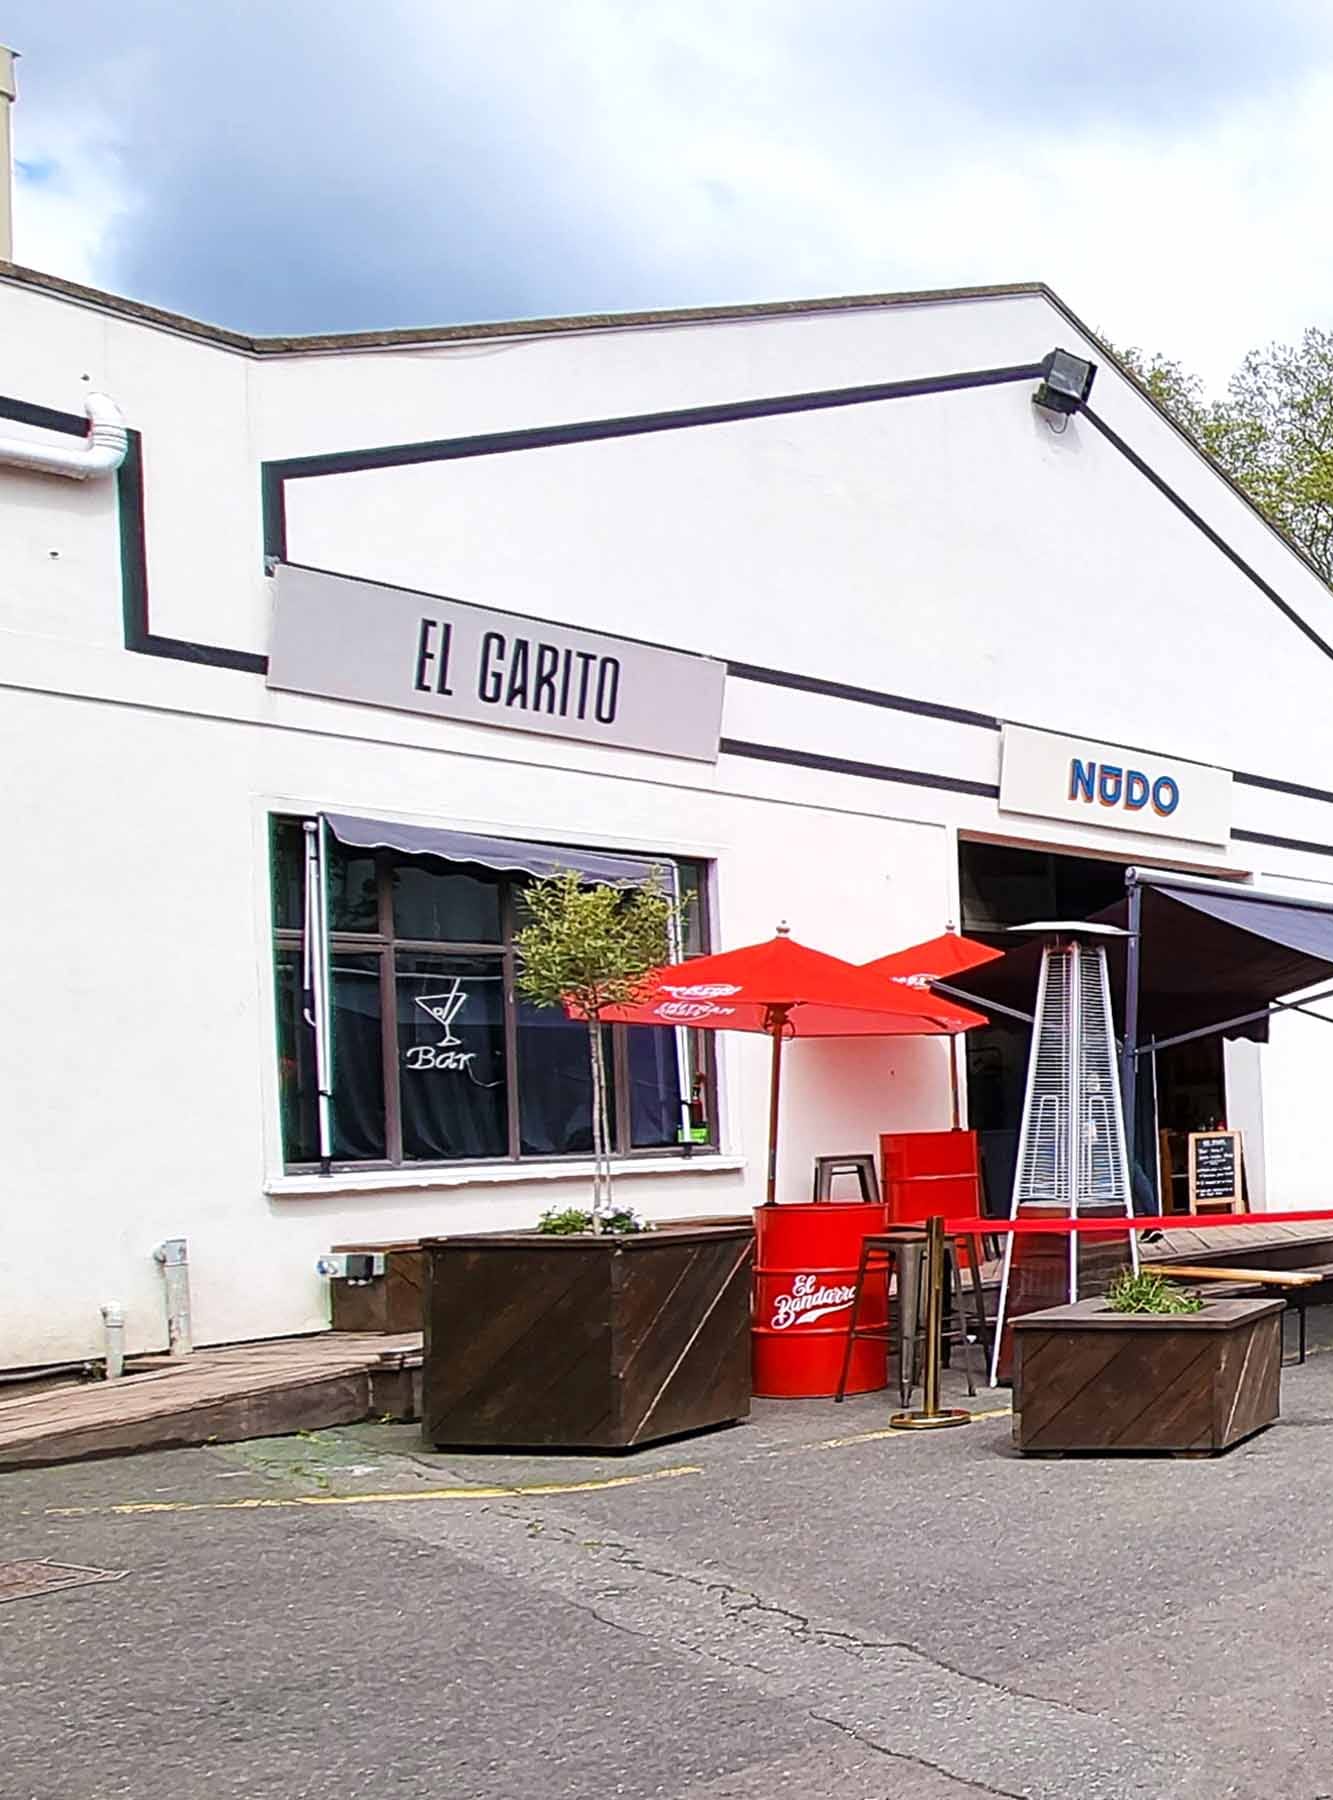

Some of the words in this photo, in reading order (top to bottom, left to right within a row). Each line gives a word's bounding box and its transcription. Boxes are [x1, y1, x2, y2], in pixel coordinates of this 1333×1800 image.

[415, 618, 453, 696] EL
[478, 631, 620, 724] GARITO
[406, 1045, 478, 1070] Bar
[792, 1274, 816, 1296] El
